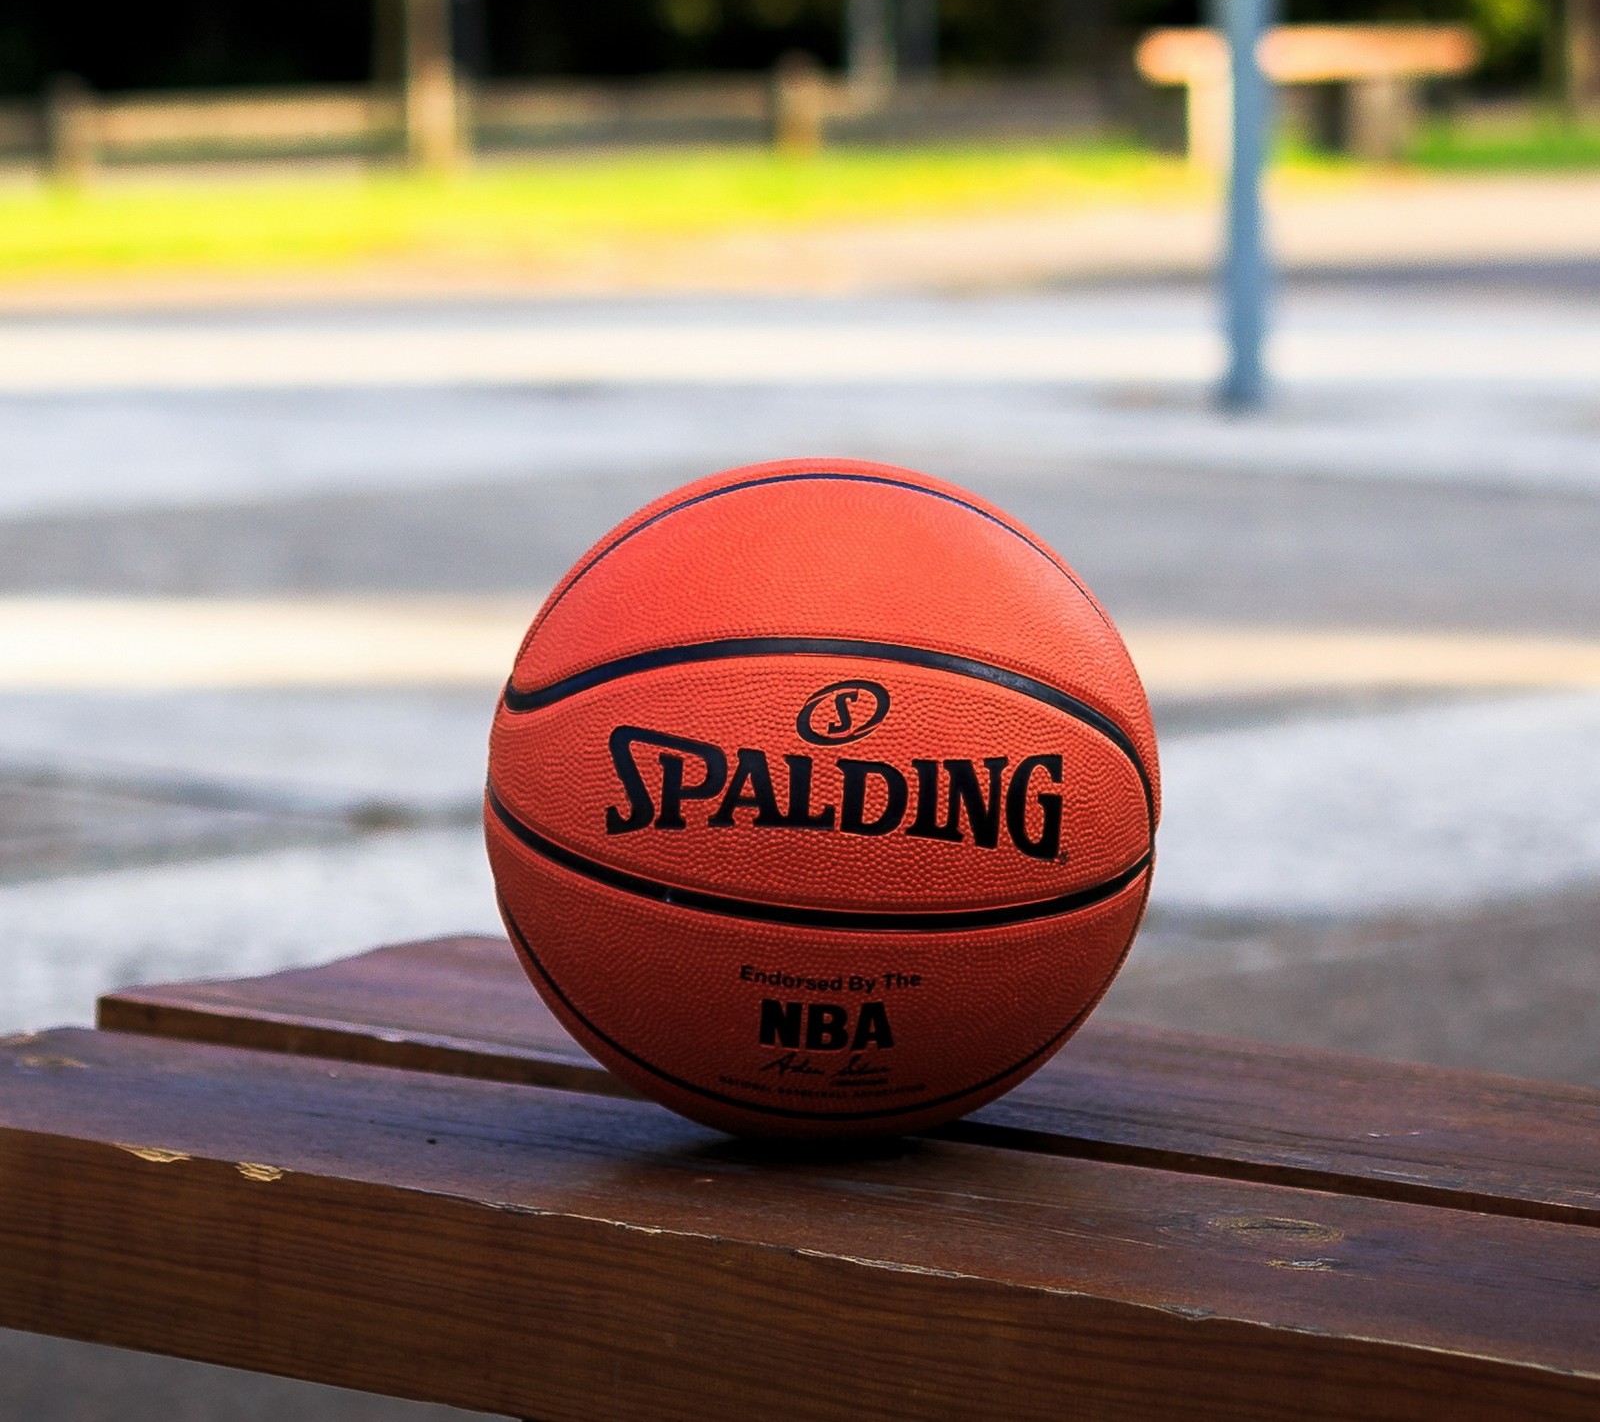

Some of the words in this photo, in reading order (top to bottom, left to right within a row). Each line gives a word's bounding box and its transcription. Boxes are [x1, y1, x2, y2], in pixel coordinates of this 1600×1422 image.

[605, 724, 1063, 861] SPALDING
[739, 964, 843, 992] Endorsed
[848, 975, 877, 994] By
[882, 972, 923, 990] The
[758, 997, 895, 1052] NBA
